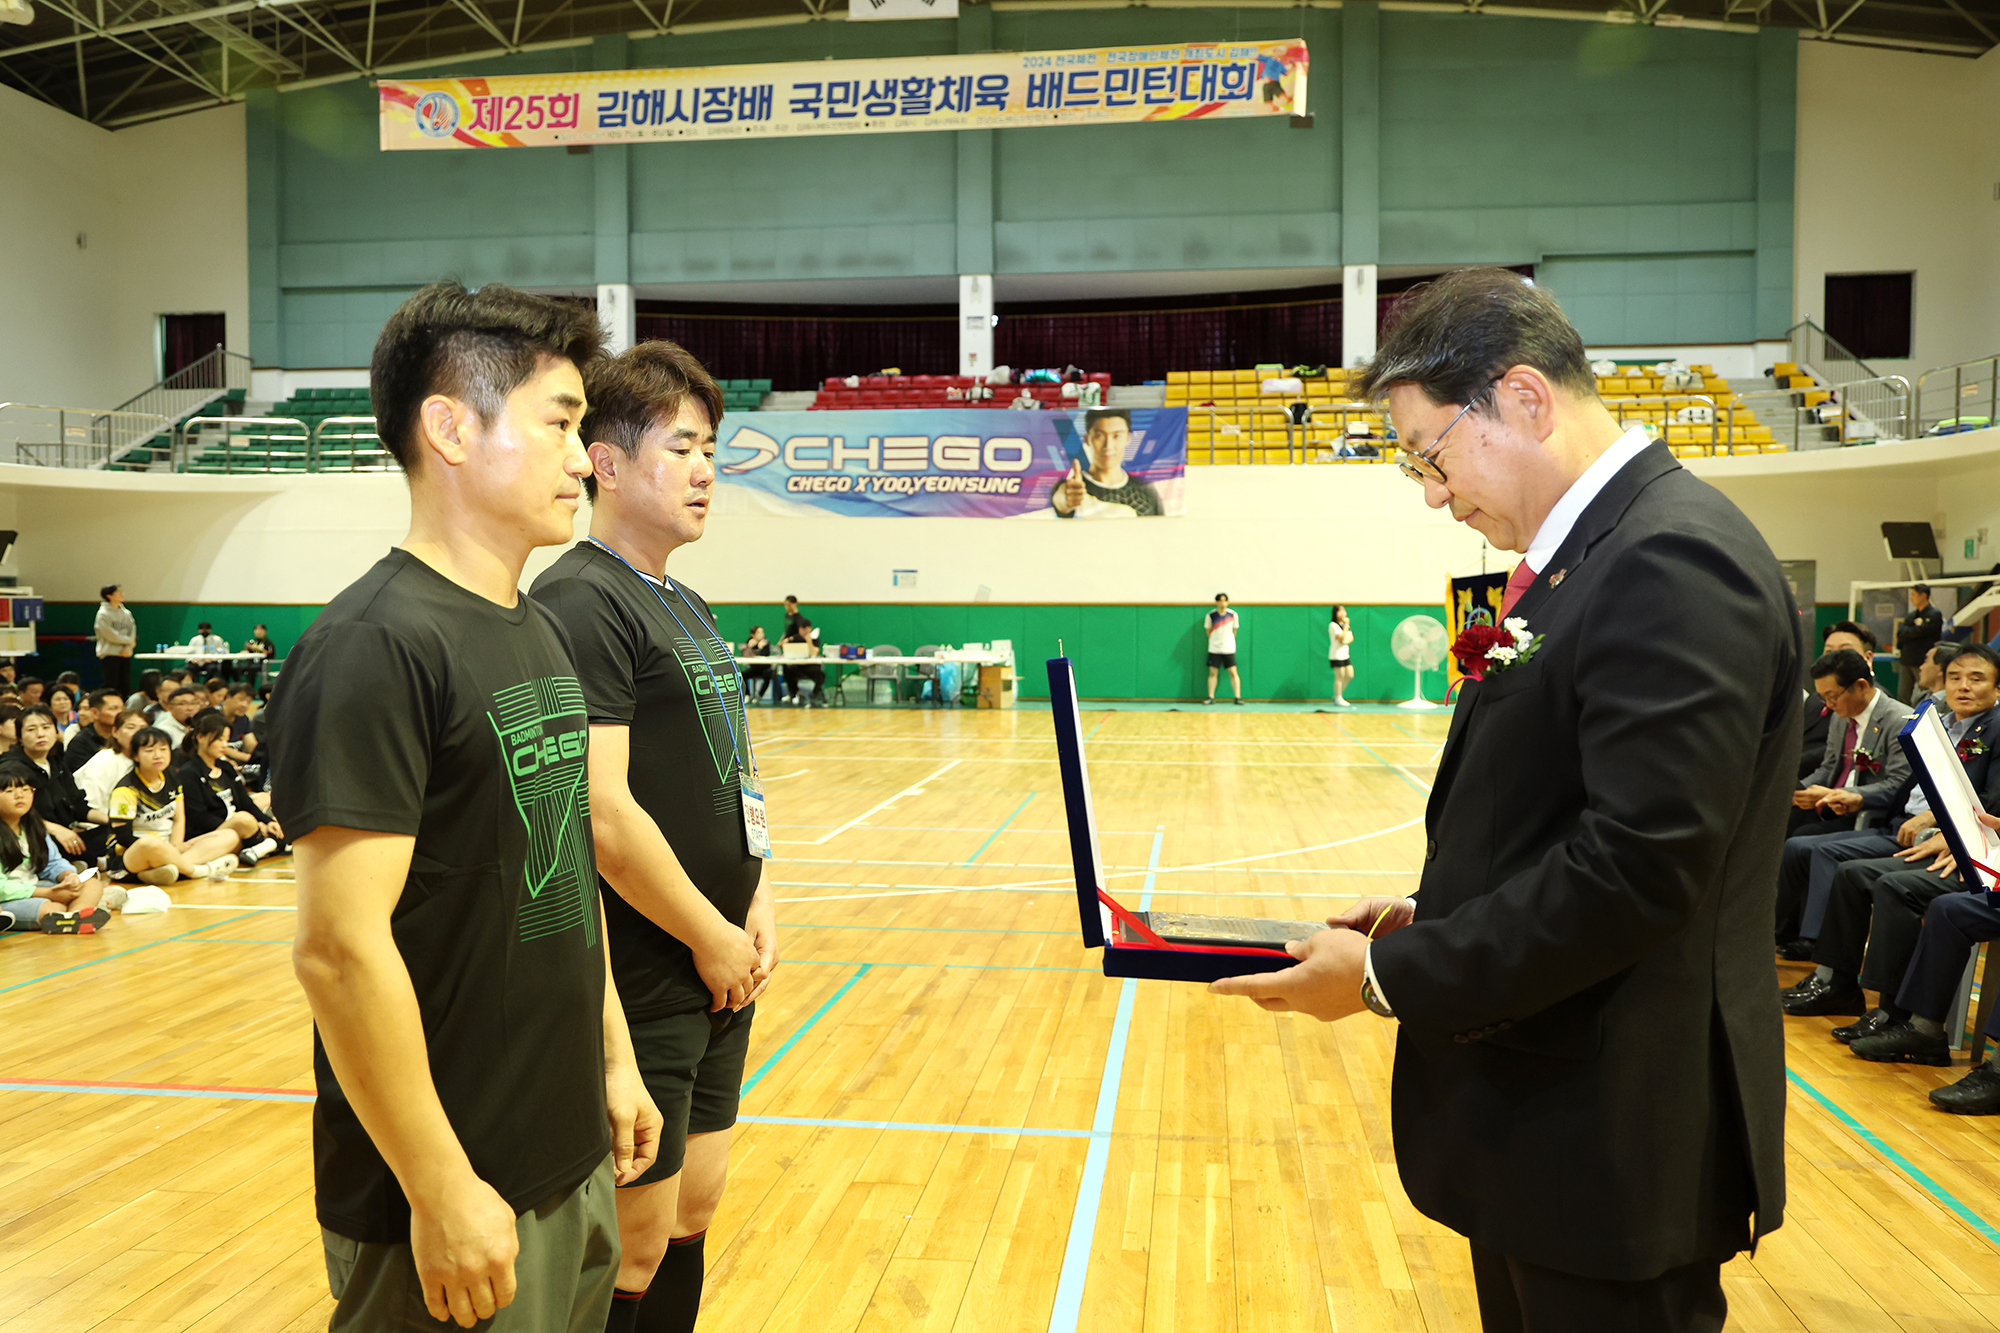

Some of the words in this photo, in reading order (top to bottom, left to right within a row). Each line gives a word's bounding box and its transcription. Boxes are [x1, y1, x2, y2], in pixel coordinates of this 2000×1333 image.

[1023, 55, 1052, 68] 2024
[469, 92, 580, 132] 제25회
[597, 84, 774, 128] 김해시장배
[789, 74, 1010, 120] 국민생활체육
[1026, 62, 1257, 110] 배드민턴대회
[783, 435, 1032, 472] CHEGO
[786, 475, 852, 493] CHEGO
[510, 725, 544, 747] BADMINTON
